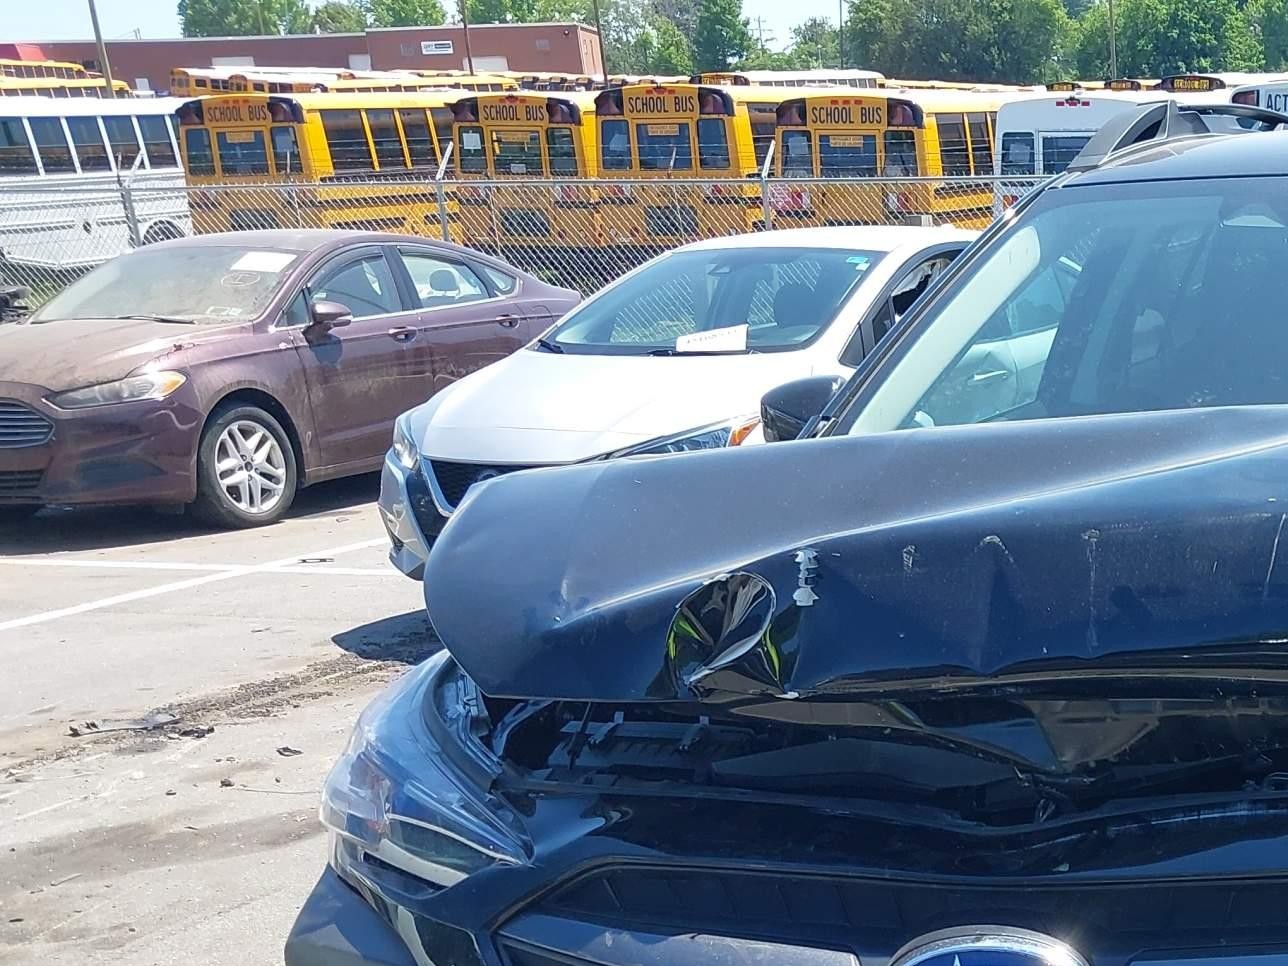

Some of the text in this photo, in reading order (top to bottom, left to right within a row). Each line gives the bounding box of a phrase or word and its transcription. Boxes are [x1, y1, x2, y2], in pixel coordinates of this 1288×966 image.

[207, 104, 267, 122] SCHOOL BUS
[482, 104, 545, 121] SCHOOL BUS
[628, 95, 695, 113] SCHOOL BUS
[811, 106, 882, 124] SCHOOL BUS
